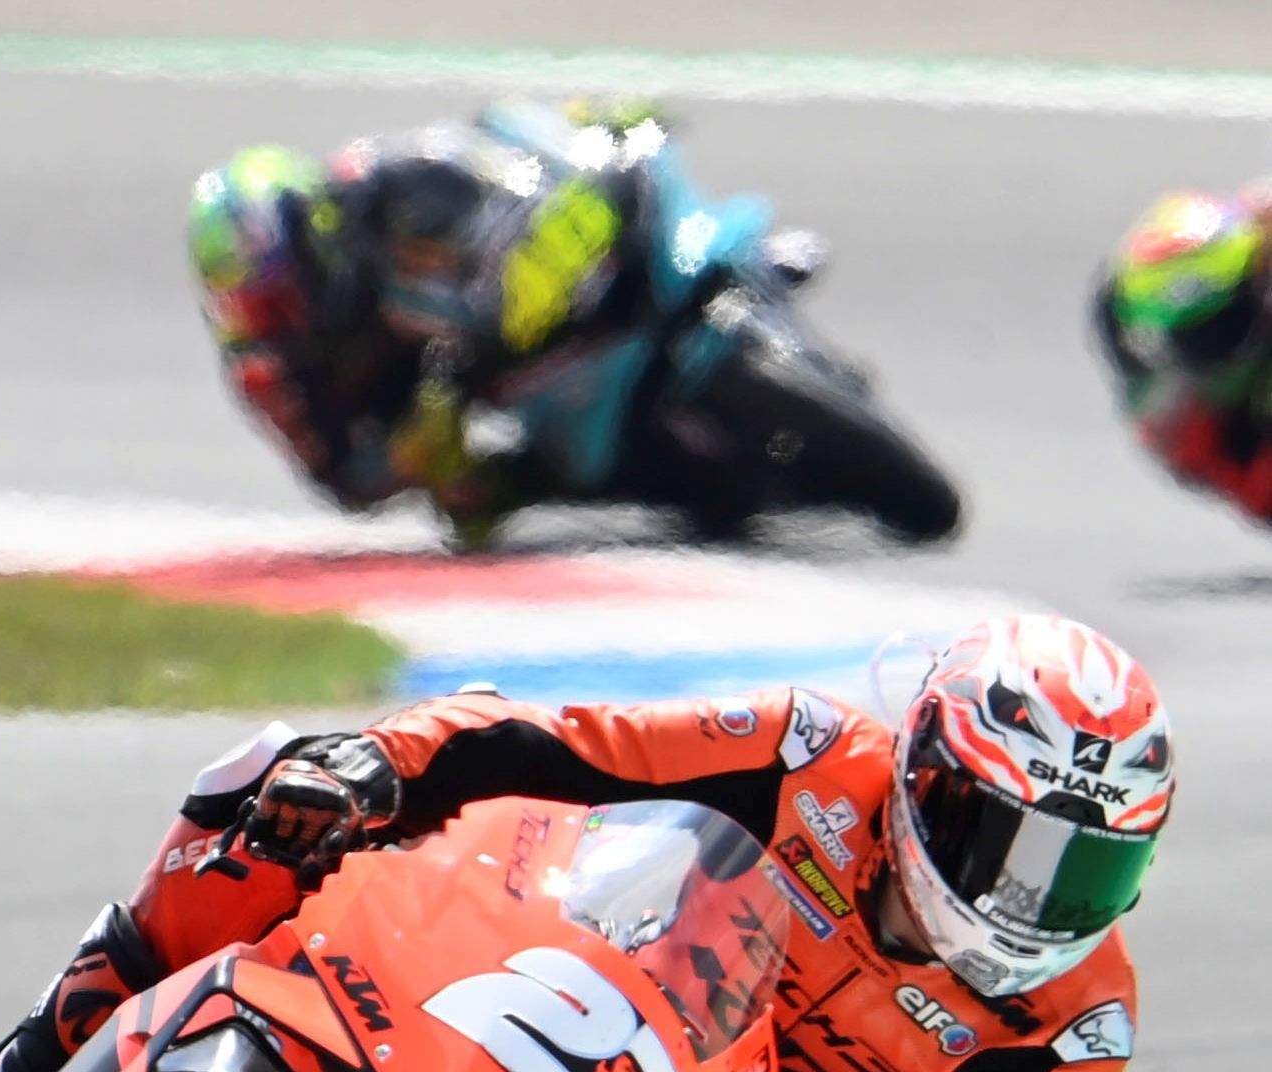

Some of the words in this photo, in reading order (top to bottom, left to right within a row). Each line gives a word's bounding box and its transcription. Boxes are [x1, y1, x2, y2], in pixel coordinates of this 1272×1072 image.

[1027, 757, 1131, 806] SHARK
[795, 791, 855, 870] SHARK
[322, 954, 394, 1032] KTM
[895, 984, 953, 1033] elf
